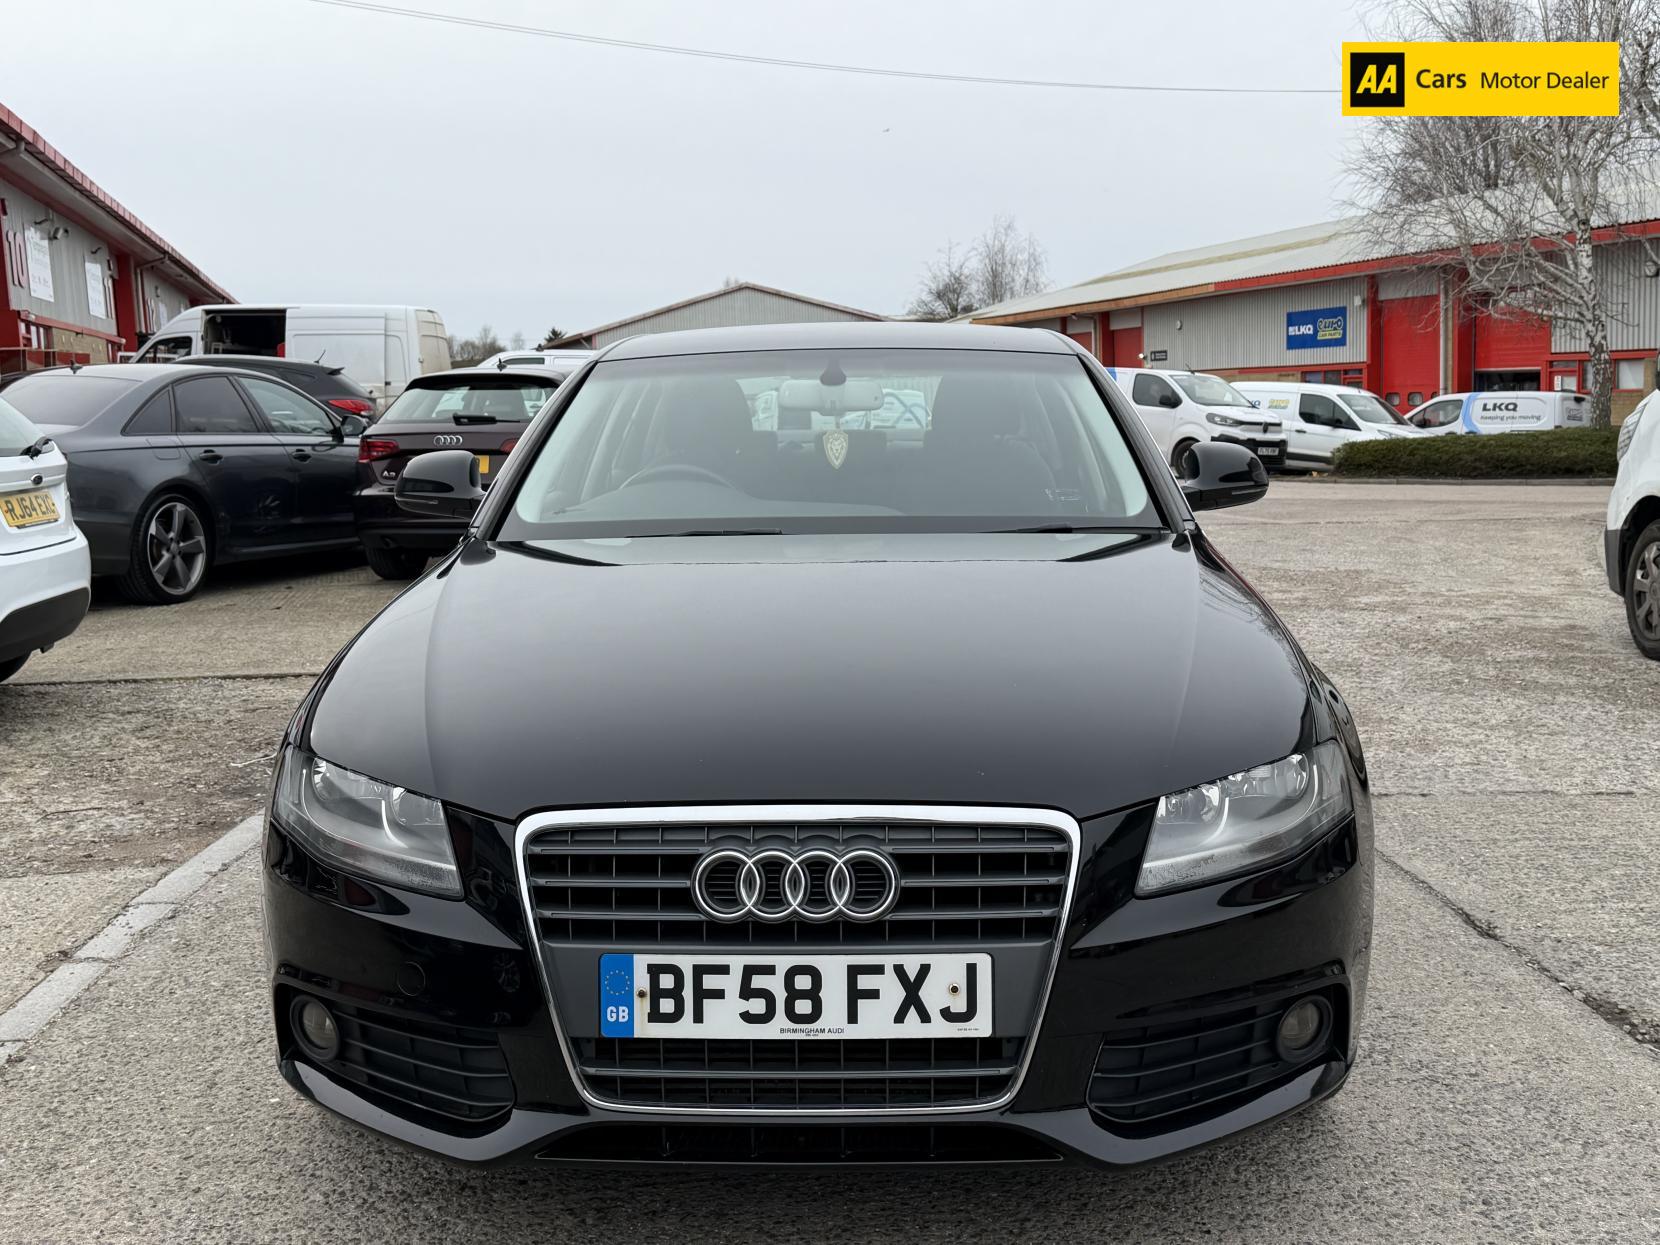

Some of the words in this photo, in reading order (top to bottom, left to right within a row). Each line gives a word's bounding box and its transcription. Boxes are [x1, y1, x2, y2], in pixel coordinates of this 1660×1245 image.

[6, 229, 28, 288] 10
[1295, 324, 1314, 335] LKQ
[1482, 402, 1518, 412] LKQ
[4, 495, 39, 521] RJ64
[647, 963, 823, 1025] BF58
[846, 962, 978, 1025] FXJ
[606, 1006, 629, 1022] GB
